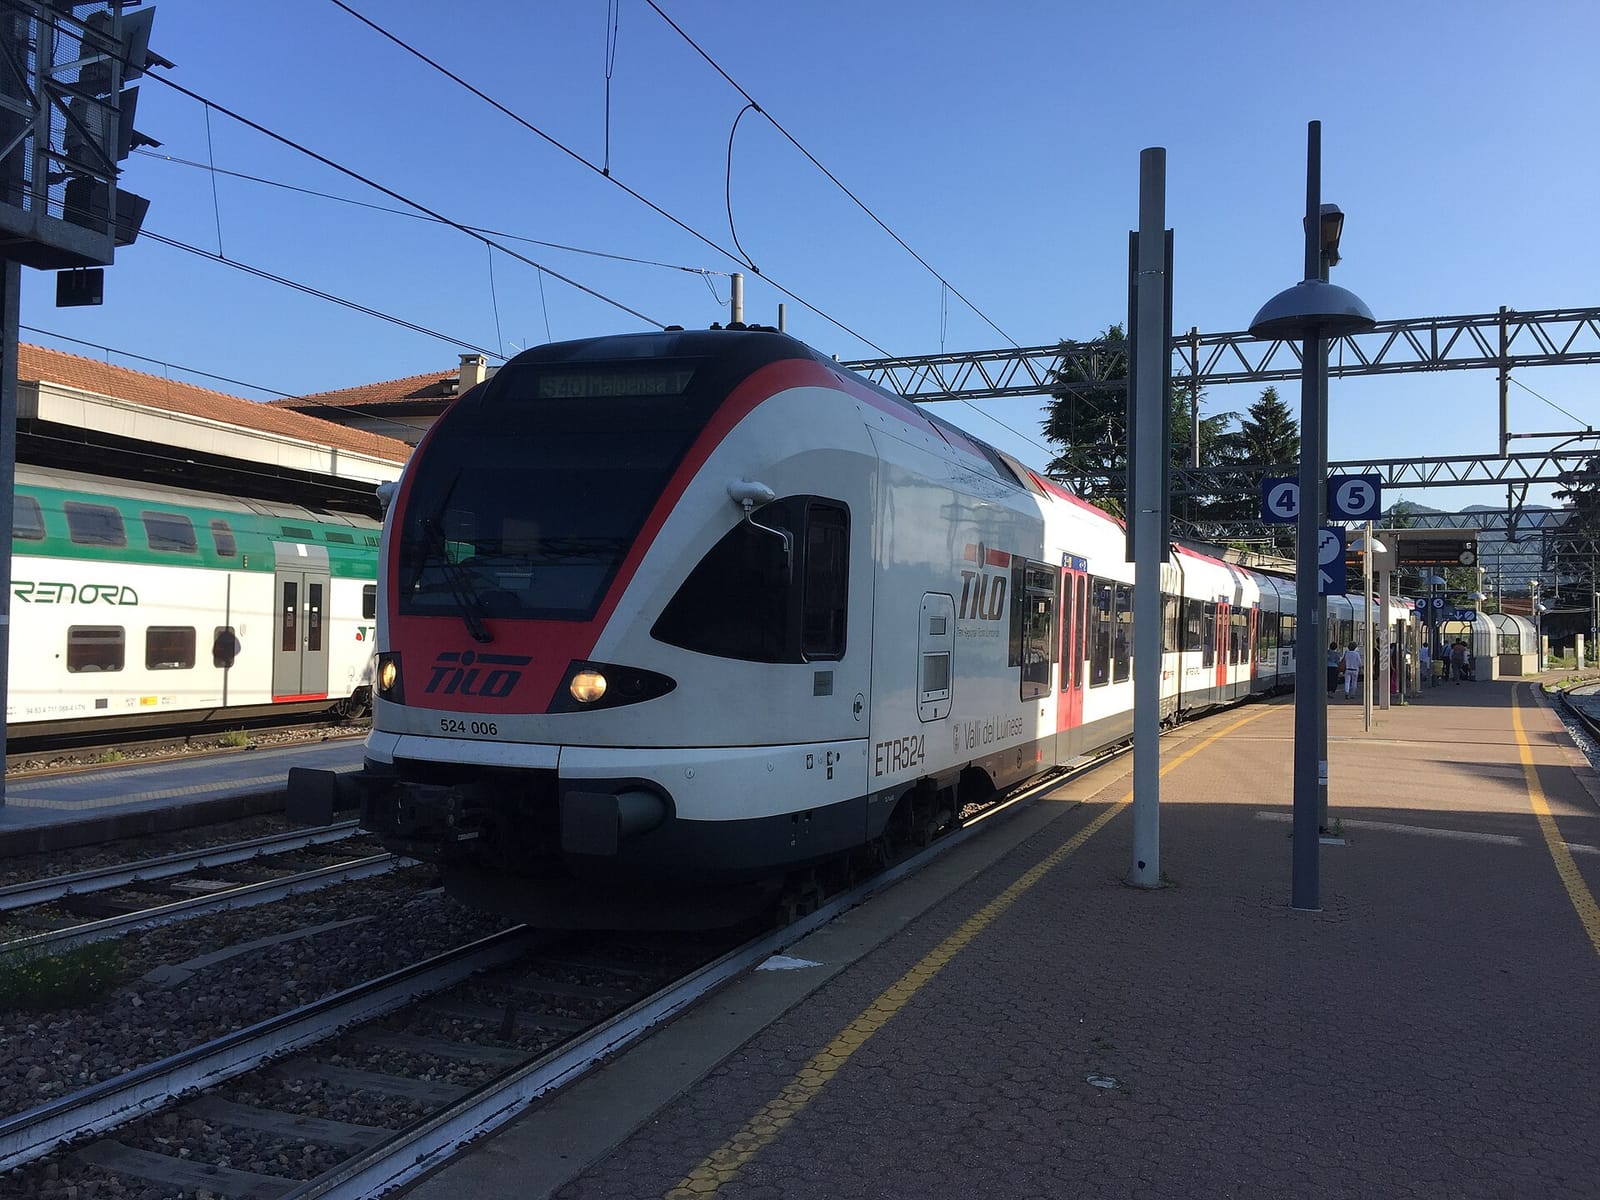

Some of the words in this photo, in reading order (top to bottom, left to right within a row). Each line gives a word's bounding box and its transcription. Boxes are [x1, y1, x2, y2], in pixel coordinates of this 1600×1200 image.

[1276, 489, 1296, 512] 4
[1347, 486, 1365, 510] 5
[10, 580, 138, 606] RENORD
[440, 718, 466, 733] 524
[471, 721, 498, 736] 006
[964, 719, 981, 750] Valli
[982, 716, 995, 744] del
[996, 713, 1023, 741] Luinese
[875, 733, 925, 777] ETR524
